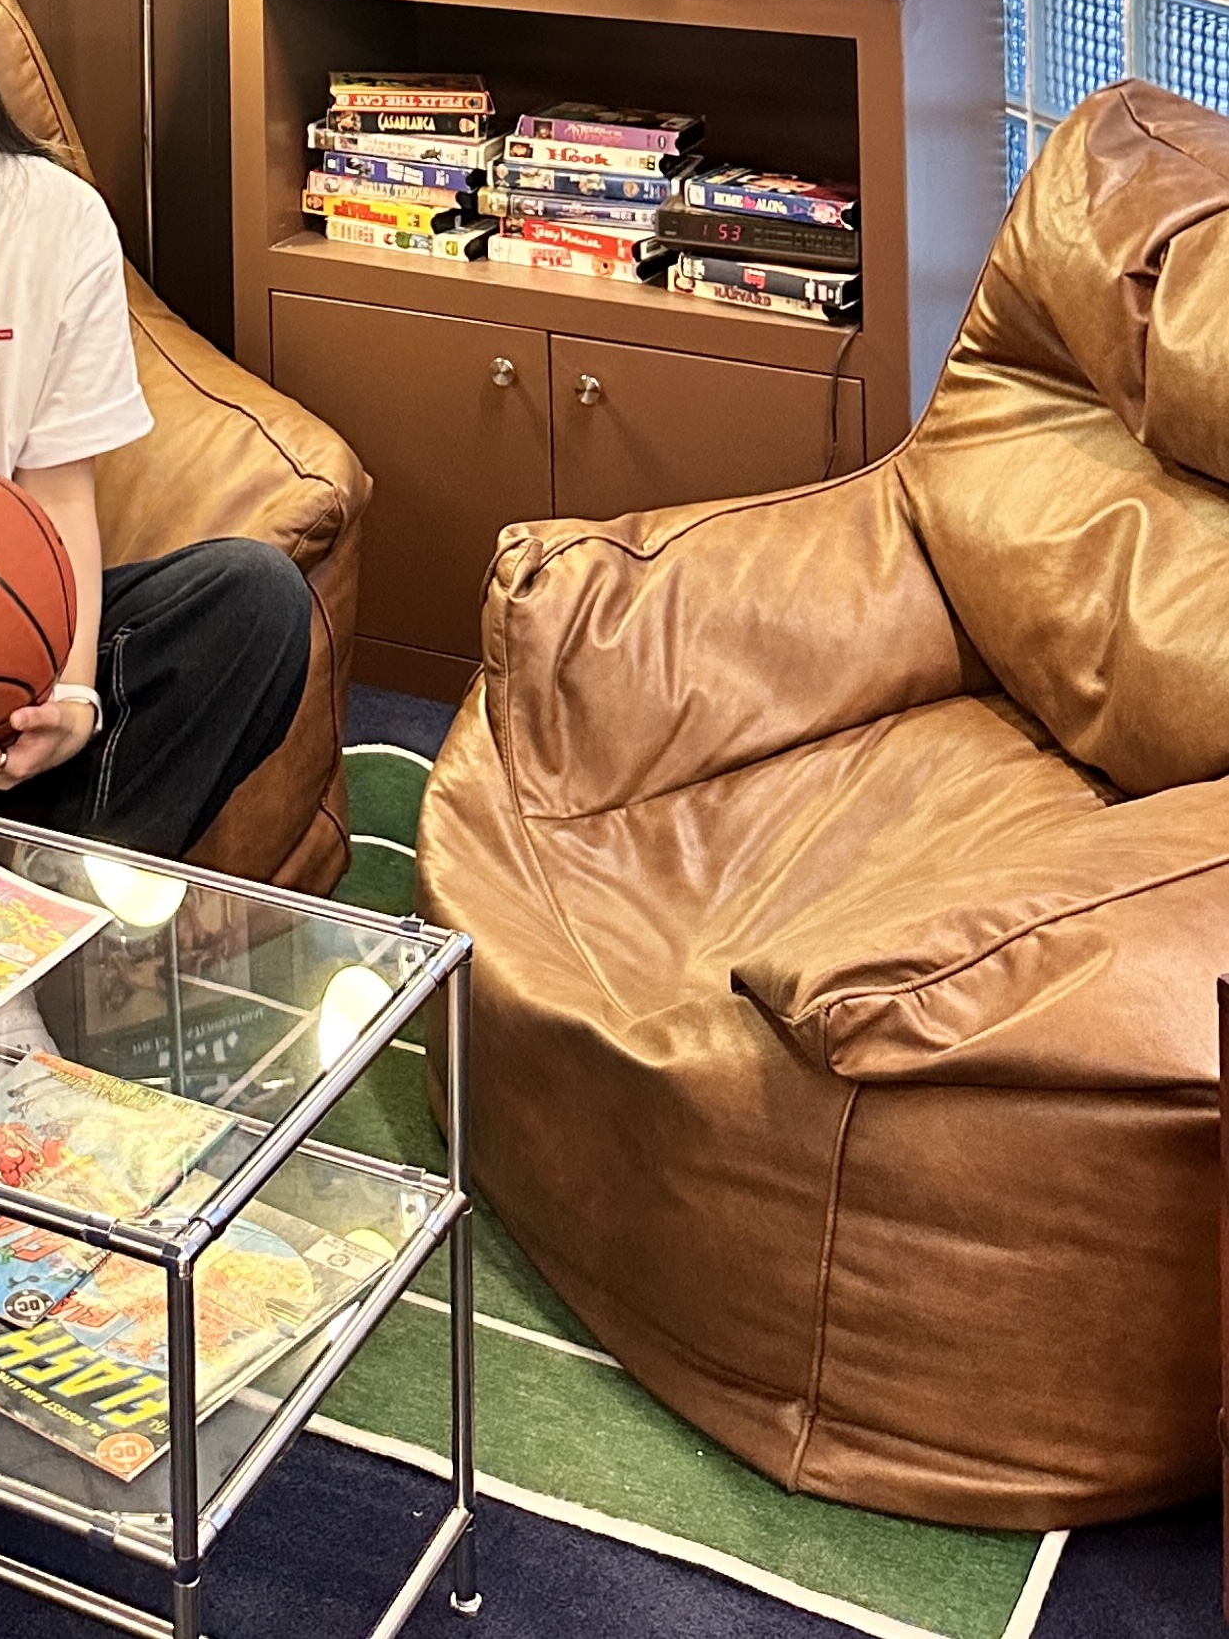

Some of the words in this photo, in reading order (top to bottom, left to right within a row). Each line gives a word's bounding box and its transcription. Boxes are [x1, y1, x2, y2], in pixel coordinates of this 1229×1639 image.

[354, 94, 384, 107] CAT
[384, 95, 416, 107] THE
[418, 95, 465, 108] FELIX
[376, 112, 437, 132] CASABLANCA
[546, 147, 612, 167] Hook
[713, 191, 744, 209] HOME
[18, 1299, 40, 1312] DC
[19, 1384, 47, 1407] MAN
[41, 1397, 89, 1427] FASTEST
[112, 1444, 138, 1458] DC
